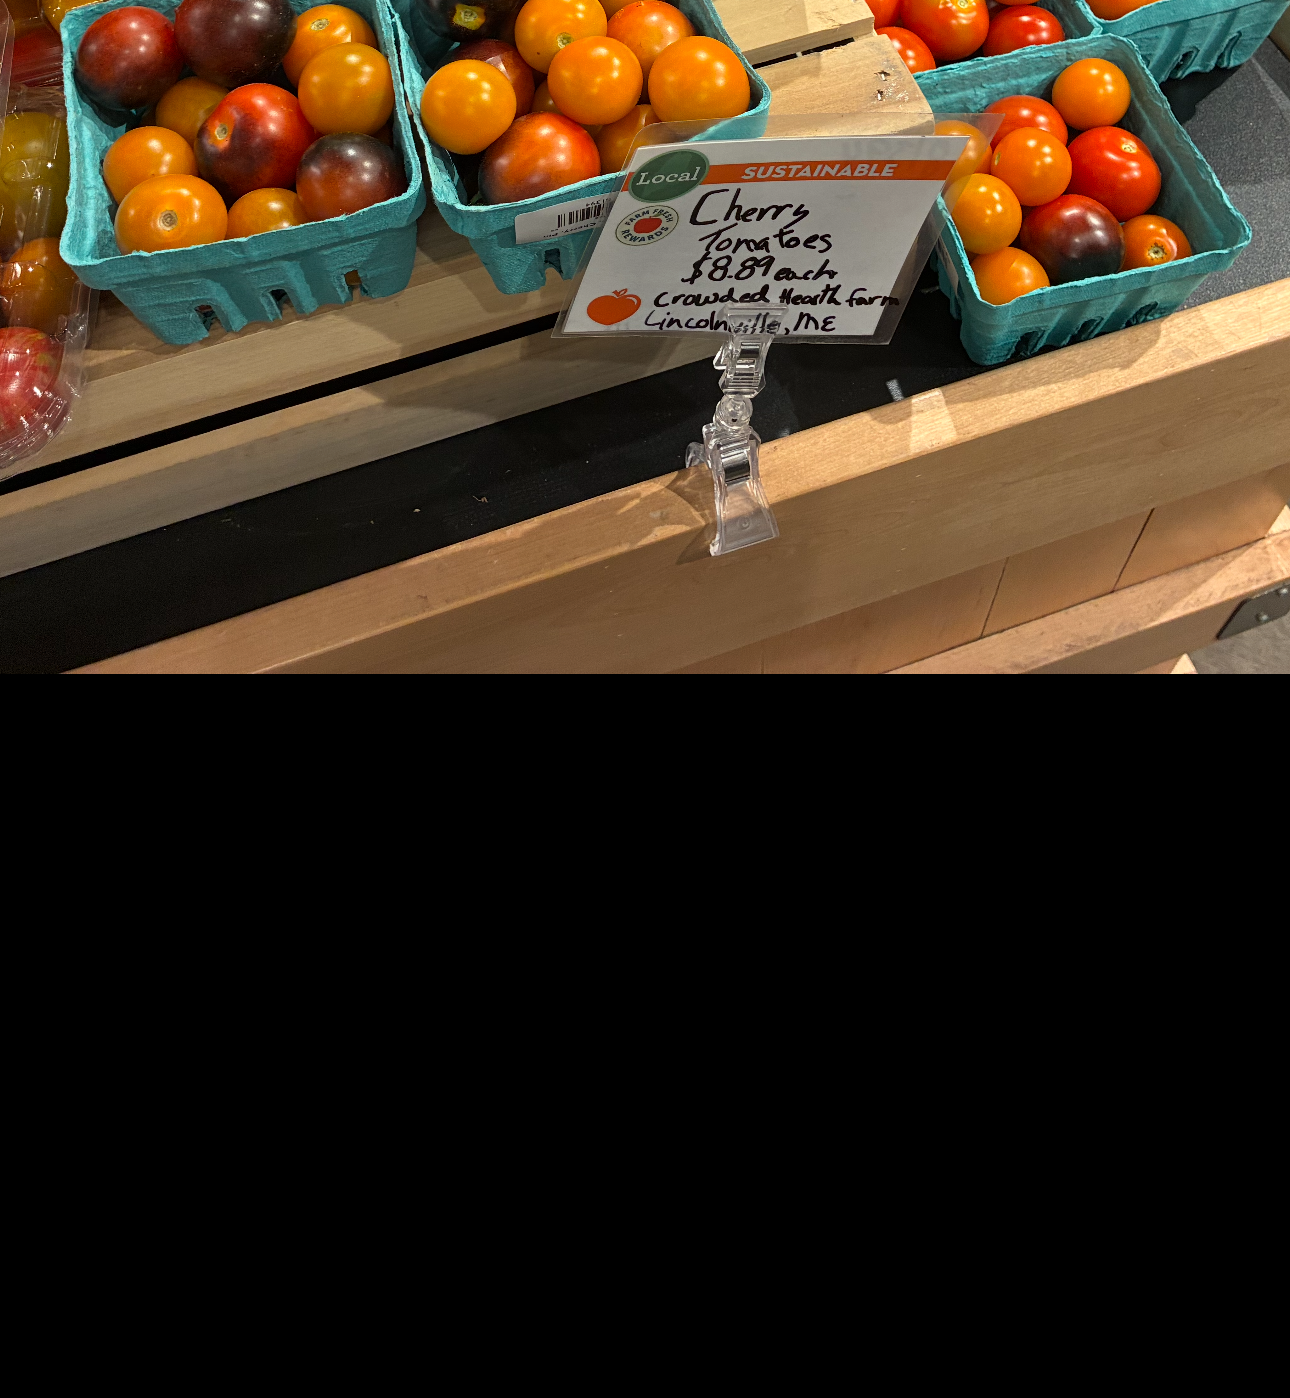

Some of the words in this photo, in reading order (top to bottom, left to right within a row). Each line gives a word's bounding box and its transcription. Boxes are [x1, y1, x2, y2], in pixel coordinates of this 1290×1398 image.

[635, 166, 701, 186] Local
[741, 163, 898, 180] SUSTAINABLE
[624, 209, 650, 226] FARM
[652, 208, 674, 223] FRESH
[689, 187, 810, 230] Cherry
[621, 226, 669, 243] REWARDS
[698, 222, 833, 254] Tomatoes
[680, 250, 776, 285] $8.89
[773, 258, 838, 282] each
[779, 284, 842, 306] Hearth
[793, 310, 837, 332] ME
